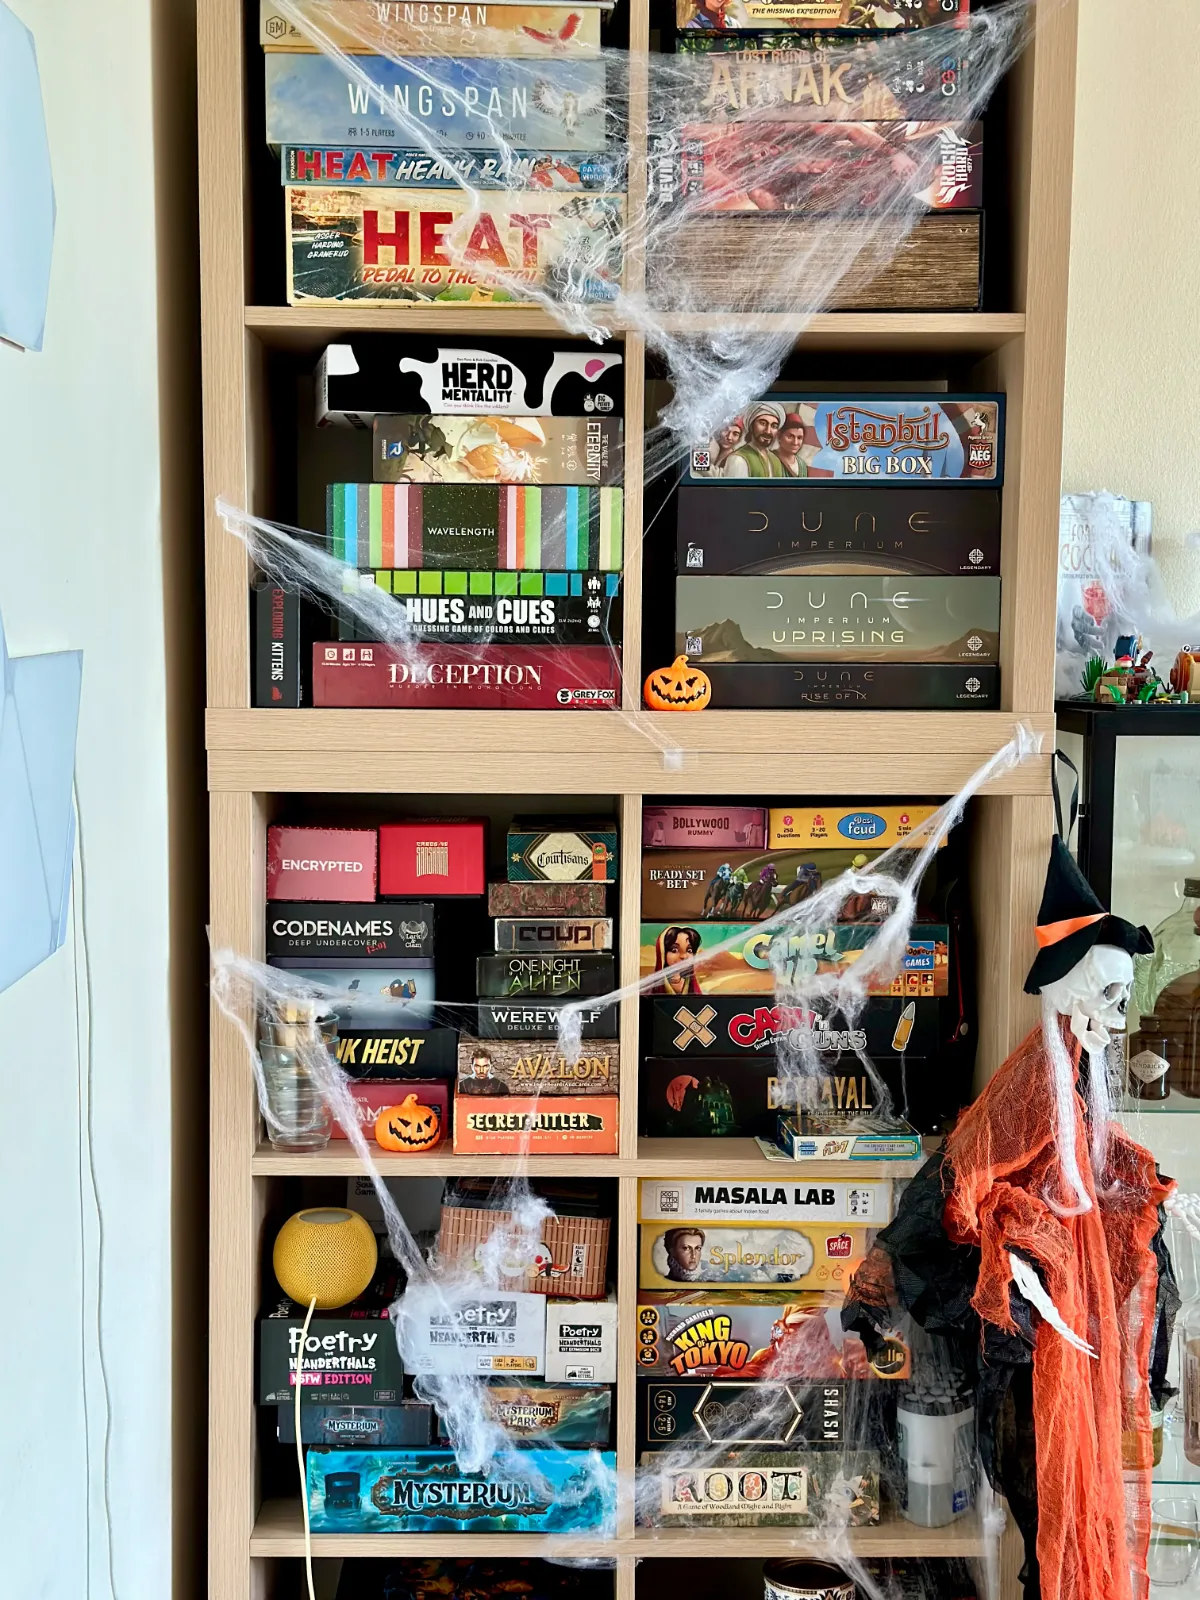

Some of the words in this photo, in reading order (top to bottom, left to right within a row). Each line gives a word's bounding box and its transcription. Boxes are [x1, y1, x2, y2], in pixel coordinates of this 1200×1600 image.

[377, 4, 487, 25] WINGSPAN
[735, 51, 768, 64] LOST
[348, 83, 527, 119] WINGSPAN
[371, 129, 395, 137] PLAYERS
[297, 151, 394, 180] HEAT
[395, 158, 476, 181] HEAVY
[940, 144, 955, 186] ROCK
[956, 148, 968, 181] HARD
[314, 232, 341, 240] ASGER
[363, 210, 553, 268] HEAT
[312, 241, 344, 249] HARDING
[307, 250, 349, 259] GRANERUD
[363, 267, 415, 284] PEDAL
[420, 268, 442, 283] TO
[447, 269, 478, 284] THE
[442, 362, 513, 389] HERD
[442, 389, 513, 403] MENTALITY
[826, 406, 950, 454] Istanbul
[587, 423, 600, 480] ETERNITY
[970, 450, 991, 462] AEG
[842, 456, 880, 475] BIG
[886, 456, 932, 475] BOX
[749, 511, 930, 533] DUNE
[427, 527, 495, 537] WAVELENGTH
[777, 541, 903, 549] IMPERIUM
[766, 591, 909, 608] DUNE
[272, 588, 284, 638] EXPLODING
[406, 598, 464, 624] HUES
[468, 605, 493, 619] AND
[496, 599, 555, 625] CUES
[452, 625, 472, 633] GAME
[486, 625, 513, 633] COLORS
[773, 631, 904, 643] UPRISING
[271, 642, 283, 680] KITTENS
[388, 663, 543, 685] DECEPTION
[794, 671, 874, 681] DUNE
[573, 690, 596, 698] GREY
[597, 690, 615, 699] FOX
[673, 817, 730, 830] BOLLYWOOD
[282, 860, 363, 873] ENCRYPTED
[537, 850, 589, 868] Courtisans
[650, 870, 684, 880] READY
[686, 870, 706, 880] SET
[666, 880, 689, 889] BET
[872, 902, 887, 911] AEG
[272, 920, 393, 936] CODENAMES
[520, 926, 592, 944] COUP
[509, 960, 538, 972] ONE
[541, 960, 581, 972] NIGHT
[906, 958, 930, 967] GAMES
[509, 973, 581, 991] ALIEN
[492, 1012, 601, 1024] WEREWLF
[728, 1003, 816, 1047] CASH
[511, 1054, 612, 1079] AVALON
[467, 1113, 524, 1129] SECRET
[532, 1113, 590, 1129] HITLER
[695, 1187, 787, 1204] MASALA
[794, 1189, 836, 1205] LAB
[829, 1241, 849, 1251] SPACE
[709, 1240, 805, 1274] Splendor
[562, 1326, 599, 1337] Poetry
[666, 1322, 686, 1341] RICHARD
[685, 1309, 714, 1324] GARFIELD
[289, 1327, 378, 1353] Poetry
[674, 1316, 730, 1351] KING
[698, 1340, 705, 1348] OF
[289, 1357, 376, 1370] NEANDERTHALS
[670, 1341, 748, 1374] TOKYO
[324, 1374, 372, 1385] EDITION
[658, 1395, 666, 1408] 14+
[498, 1405, 553, 1417] MYSTERIUM
[824, 1389, 838, 1438] SHASN
[328, 1420, 378, 1431] MYSTERIUM
[510, 1416, 537, 1426] PARK
[671, 1471, 803, 1502] ROOT
[391, 1481, 531, 1509] MYSTERIUM
